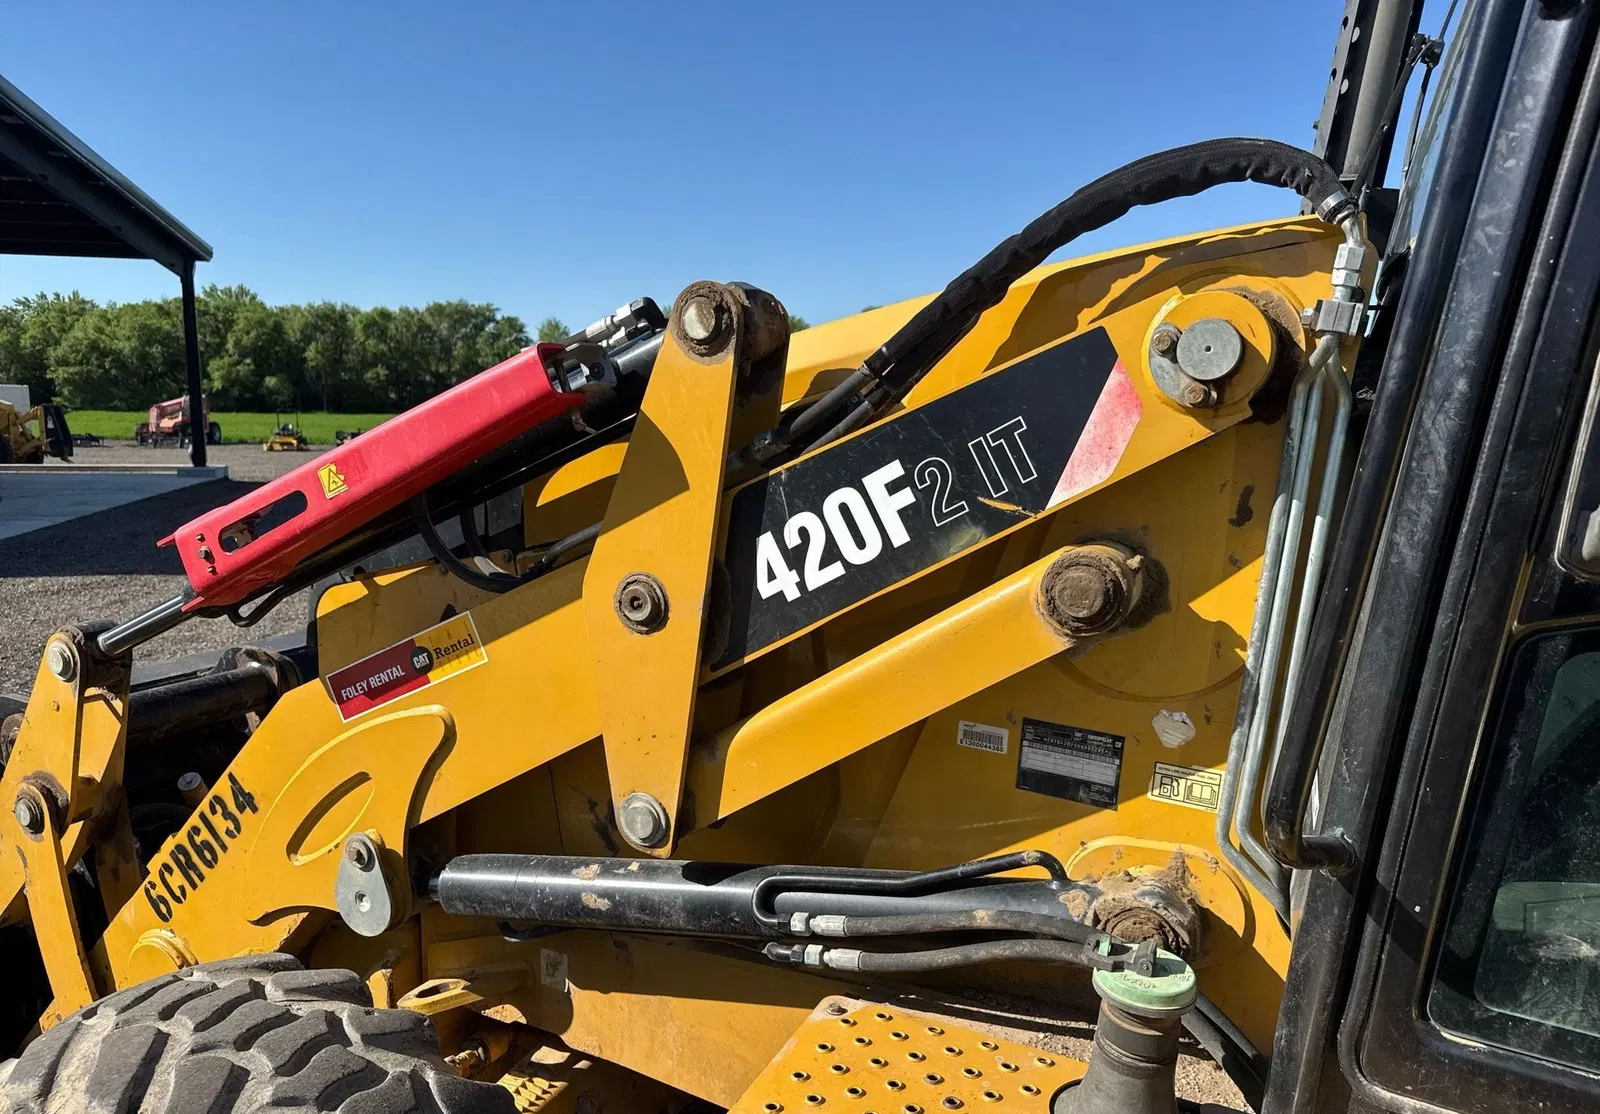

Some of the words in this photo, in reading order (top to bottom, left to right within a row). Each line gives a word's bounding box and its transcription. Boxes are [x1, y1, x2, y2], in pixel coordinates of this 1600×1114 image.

[967, 415, 1038, 498] IT
[413, 652, 430, 669] CAT
[433, 633, 476, 659] Rental
[341, 682, 370, 701] FOLEY
[369, 665, 406, 688] RENTAL
[143, 771, 260, 924] 6CR6134
